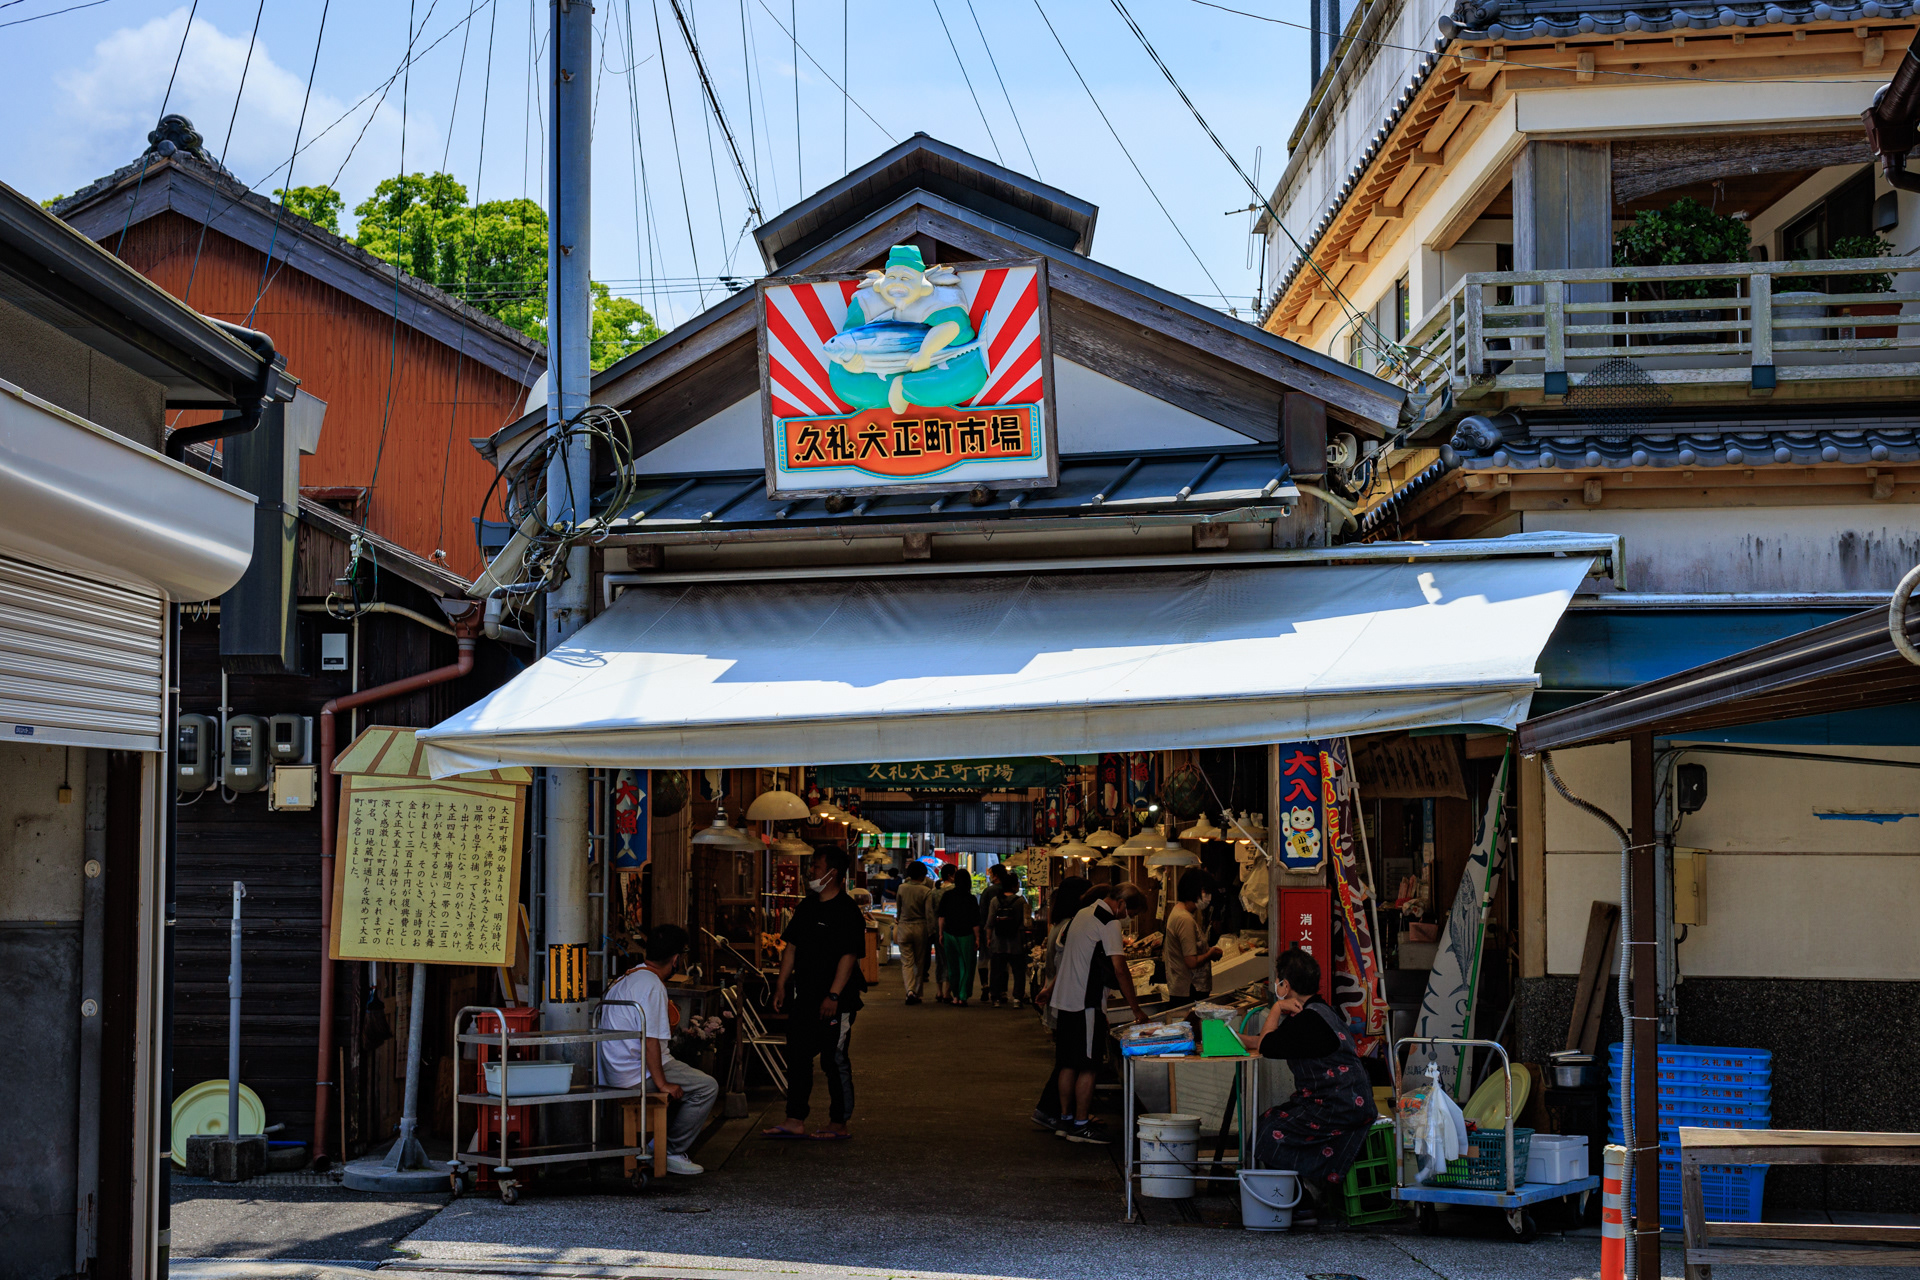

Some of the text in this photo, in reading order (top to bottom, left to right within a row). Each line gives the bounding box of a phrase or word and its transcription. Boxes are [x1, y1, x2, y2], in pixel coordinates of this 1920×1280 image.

[794, 415, 1023, 462] 久礼大正町市場
[867, 763, 1015, 783] 久礼大正町市場
[1283, 749, 1318, 803] 大入
[616, 780, 638, 834] 大漁
[350, 798, 365, 879] 町と命名しました。
[372, 799, 392, 945] 深く感激した町民は、それまでの
[385, 800, 404, 946] て大正天皇より届けられ、これに
[400, 800, 418, 946] 金にして三百五十円が復興費とし
[412, 801, 431, 947] われました。そのとき、当時のお
[425, 802, 444, 948] 十戸が焼失するという大火に見舞
[438, 803, 457, 948] 大正四年、市場周辺一帯の二百三
[452, 803, 470, 952] り出すようになったのがきっかけ。
[491, 805, 510, 952] 大正町市場の始まりは、明治時代
[1300, 913, 1312, 955] 消火器
[1701, 1059, 1744, 1067] 久礼漁協
[1701, 1074, 1744, 1082] 久礼漁協
[1701, 1089, 1744, 1098] 久礼漁協
[1701, 1105, 1744, 1114] 久礼漁協
[1701, 1120, 1744, 1128] 久礼漁協
[1701, 1165, 1744, 1174] 久礼漁協
